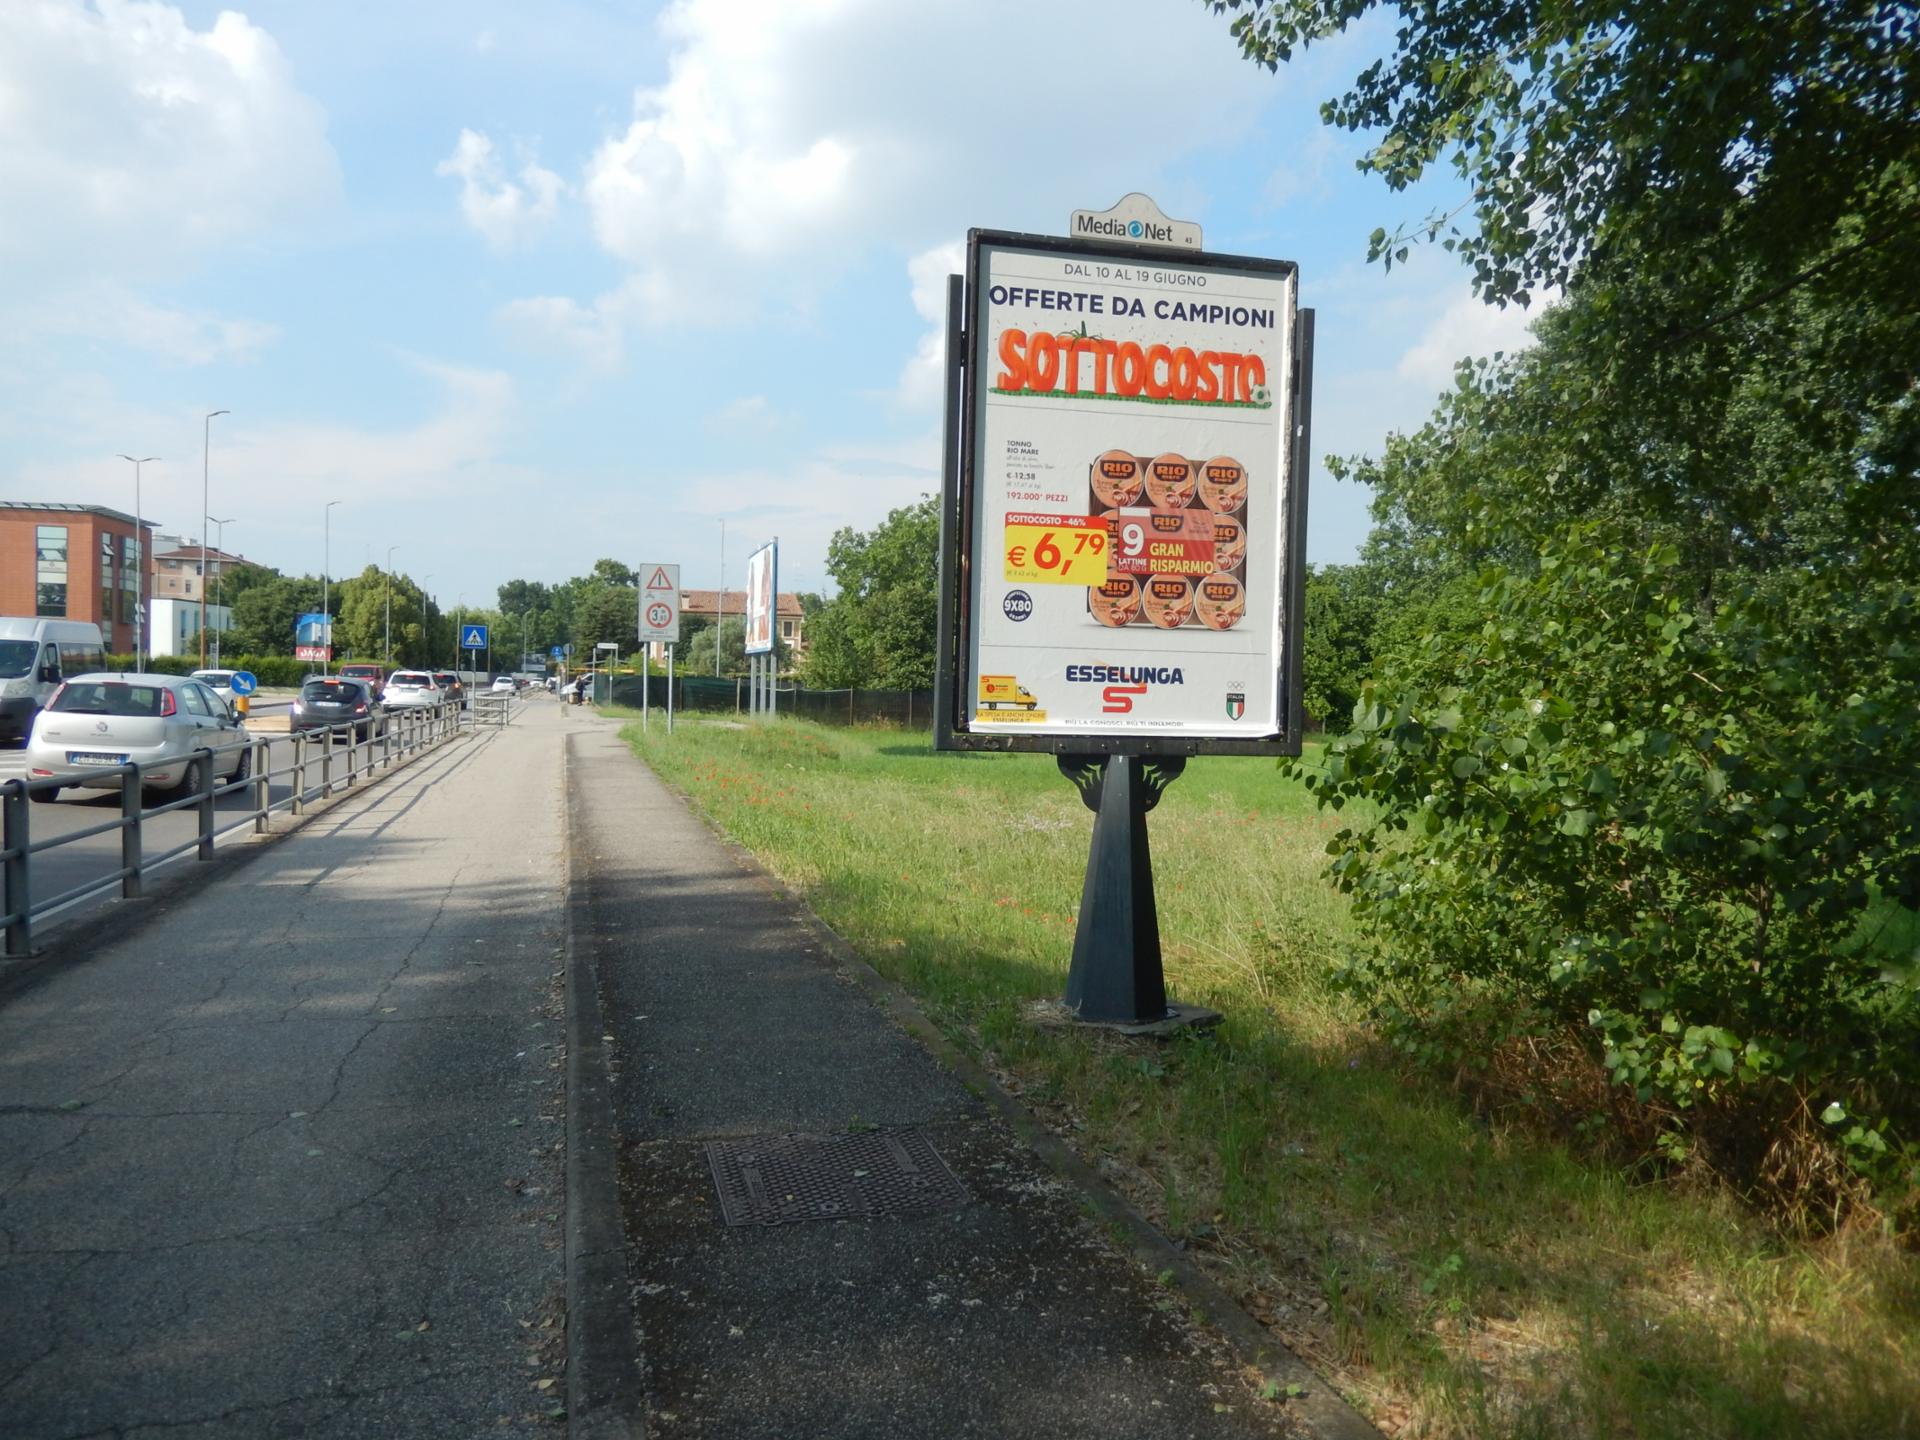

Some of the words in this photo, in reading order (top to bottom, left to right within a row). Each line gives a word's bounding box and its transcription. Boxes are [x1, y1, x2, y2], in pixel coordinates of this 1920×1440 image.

[1078, 215, 1126, 236] Media
[1145, 223, 1173, 241] Net
[1064, 264, 1091, 276] DAL
[1096, 266, 1110, 278] 10
[1114, 269, 1132, 280] AL
[1136, 270, 1149, 281] 19
[1153, 272, 1207, 287] GIUGNO
[989, 285, 1104, 314] OFFERTE
[1112, 296, 1146, 318] DA
[1154, 300, 1274, 328] CAMPIONI
[997, 328, 1268, 403] SOTTOCOSTO
[1103, 463, 1133, 473] RIO
[1156, 466, 1185, 475] RIO
[1209, 469, 1237, 478] RIO
[1046, 494, 1068, 502] PEZZI
[1008, 514, 1062, 525] SOTTOCOSTO
[1153, 517, 1180, 526] RIO
[1122, 523, 1145, 556] 9
[1150, 542, 1184, 557] GRAN
[1118, 558, 1147, 566] LATTINE
[1150, 559, 1214, 574] RISPARMIO
[1154, 583, 1183, 593] RIO
[1206, 585, 1235, 595] RIO
[1004, 600, 1031, 612] 9X80
[1066, 665, 1184, 684] ESSELUNGA
